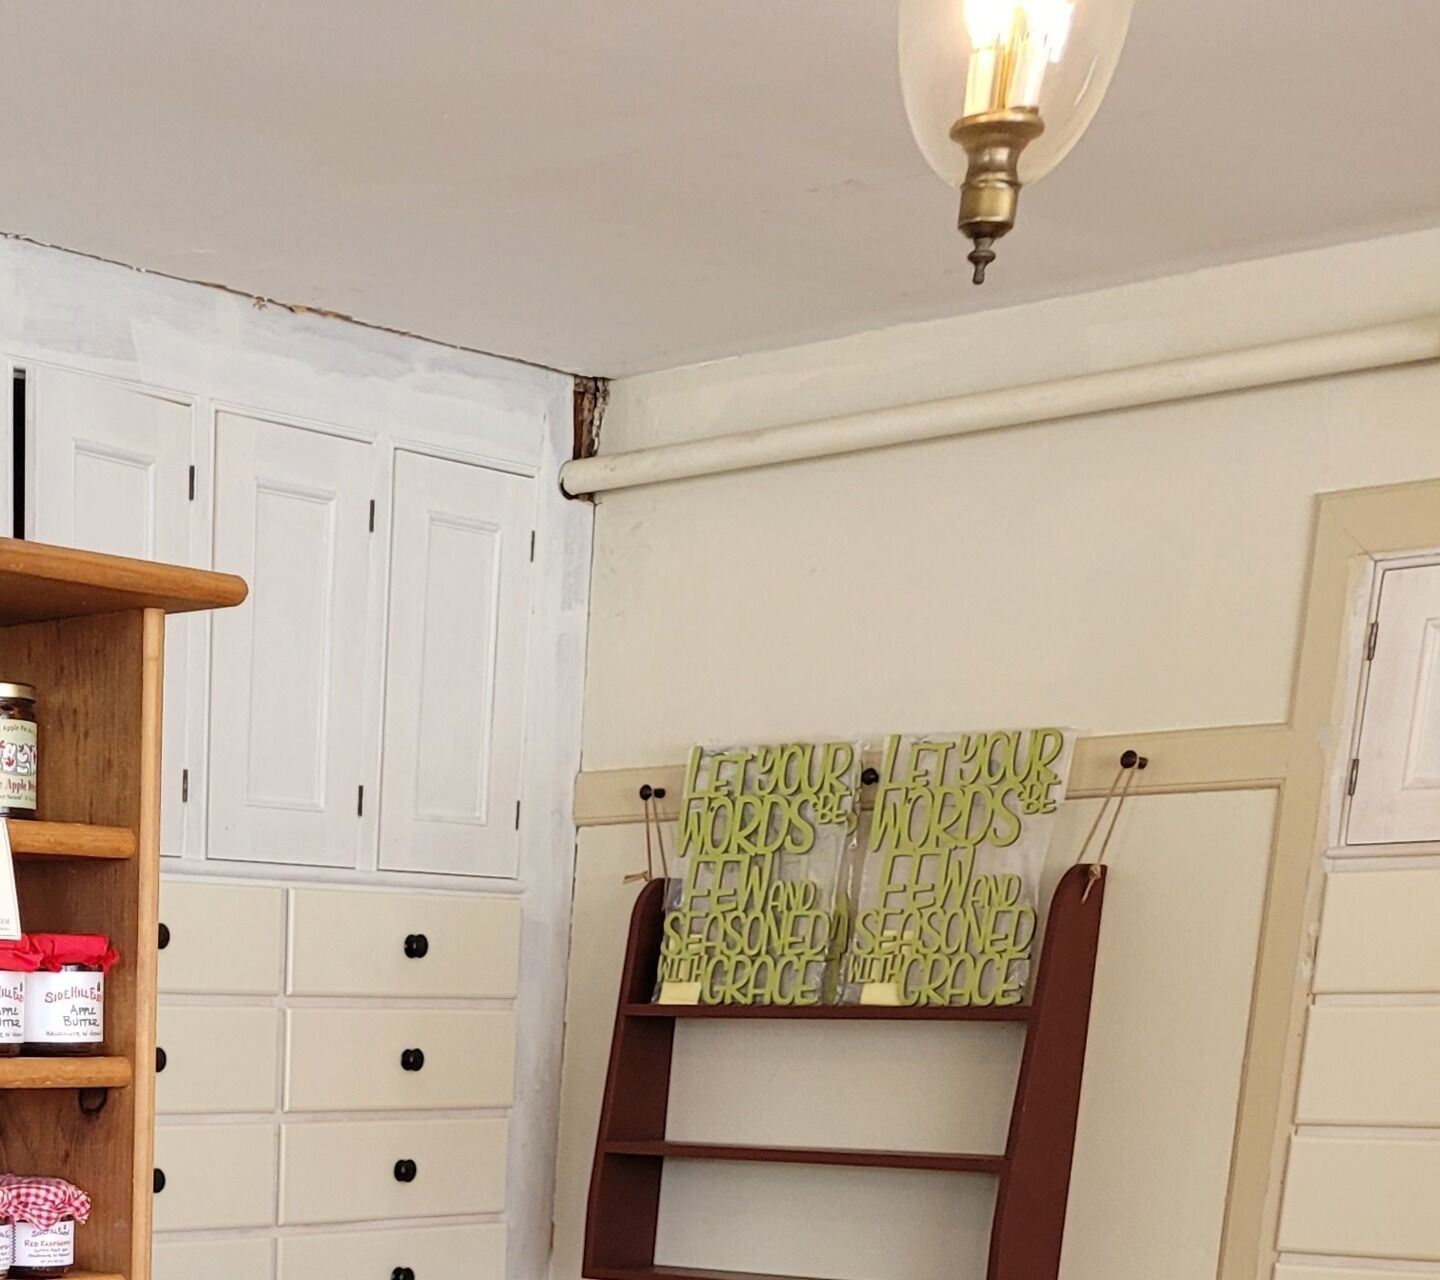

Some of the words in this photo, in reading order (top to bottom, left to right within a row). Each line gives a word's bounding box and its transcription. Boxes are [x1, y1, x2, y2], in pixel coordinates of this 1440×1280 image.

[686, 745, 755, 800] LET
[756, 743, 854, 796] YOUR
[882, 734, 955, 788] LET
[959, 728, 1063, 786] YOUR
[4, 778, 26, 795] Apple
[677, 793, 816, 857] WORDS
[871, 784, 1021, 852] WORDS
[687, 853, 774, 913] FEW
[769, 880, 816, 911] AND
[881, 847, 975, 908] FEW
[971, 875, 1022, 907] AND
[662, 910, 831, 957] SEASONED
[854, 904, 1037, 955] SEASONED
[658, 954, 704, 983] WITH
[700, 954, 818, 1005] GRACE
[848, 954, 903, 983] WITH
[898, 953, 1029, 1006] GRACE
[71, 1004, 96, 1016] APPLE
[24, 1240, 39, 1248] RED
